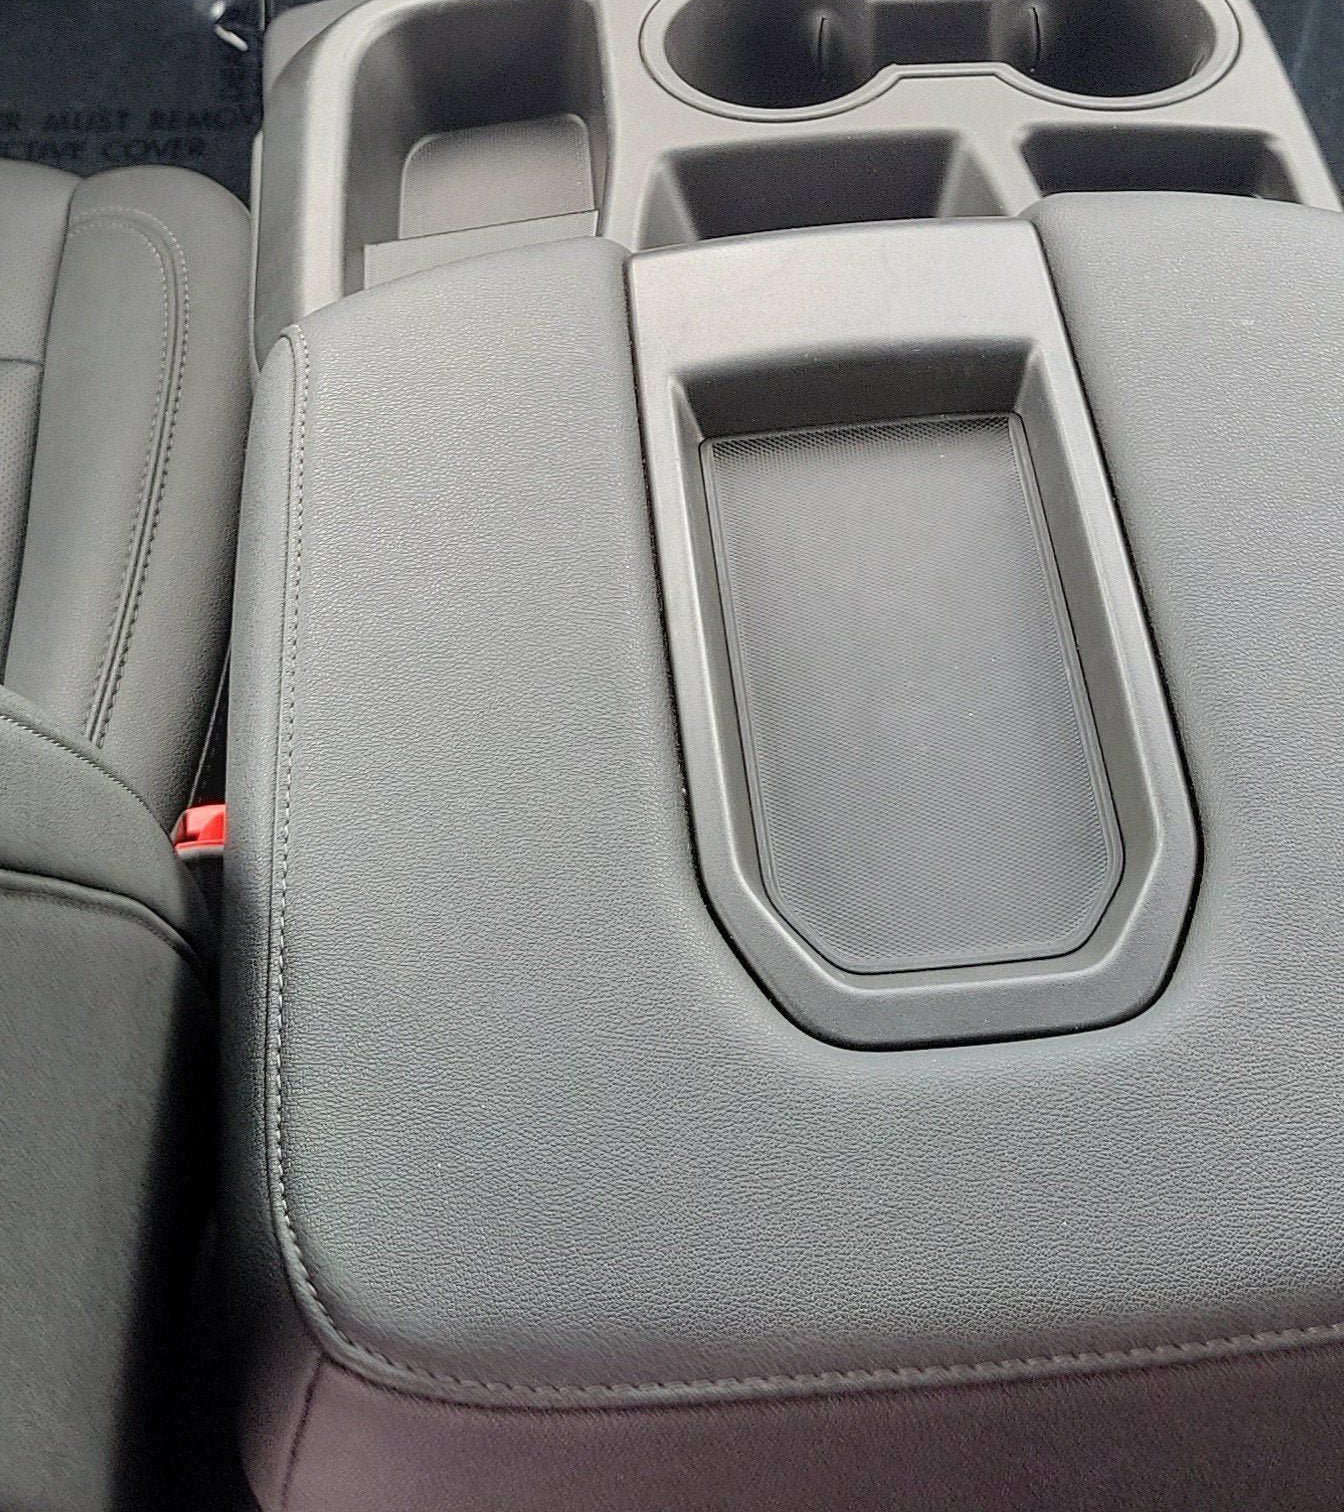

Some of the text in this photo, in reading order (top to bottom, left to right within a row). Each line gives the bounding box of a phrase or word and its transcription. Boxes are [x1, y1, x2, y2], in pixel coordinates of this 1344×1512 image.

[43, 108, 131, 132] MUST
[148, 104, 263, 131] REMOV
[100, 137, 208, 161] COVER
